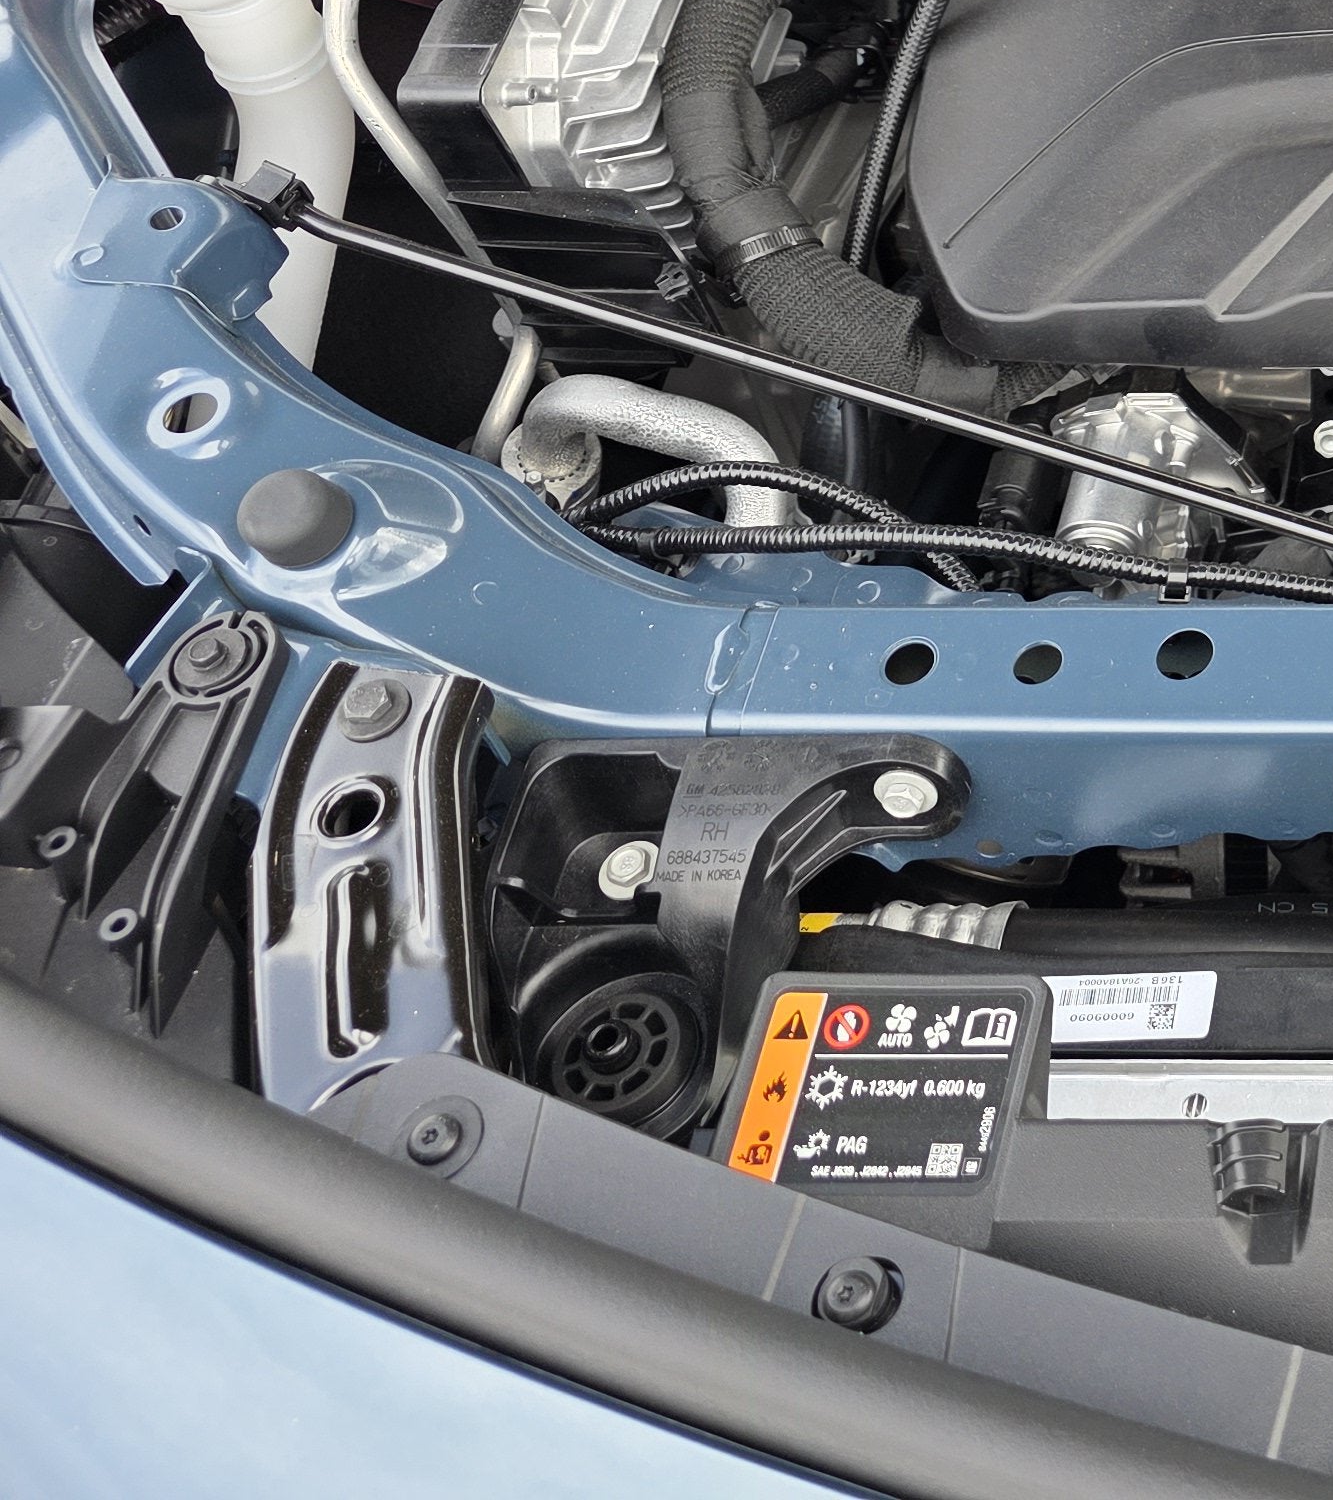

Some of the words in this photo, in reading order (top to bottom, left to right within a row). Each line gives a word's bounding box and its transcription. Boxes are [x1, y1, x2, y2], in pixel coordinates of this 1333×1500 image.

[700, 821, 730, 842] RH
[666, 847, 747, 866] 688437545
[655, 870, 686, 883] MADE
[691, 870, 702, 882] IN
[707, 869, 742, 881] KOREA
[1257, 901, 1295, 914] CN
[877, 1032, 913, 1048] AUTO
[851, 1080, 918, 1100] R-1234yf
[923, 1080, 964, 1097] 0.600
[966, 1080, 986, 1100] kg
[835, 1136, 868, 1155] PAG
[810, 1165, 830, 1178] SAE
